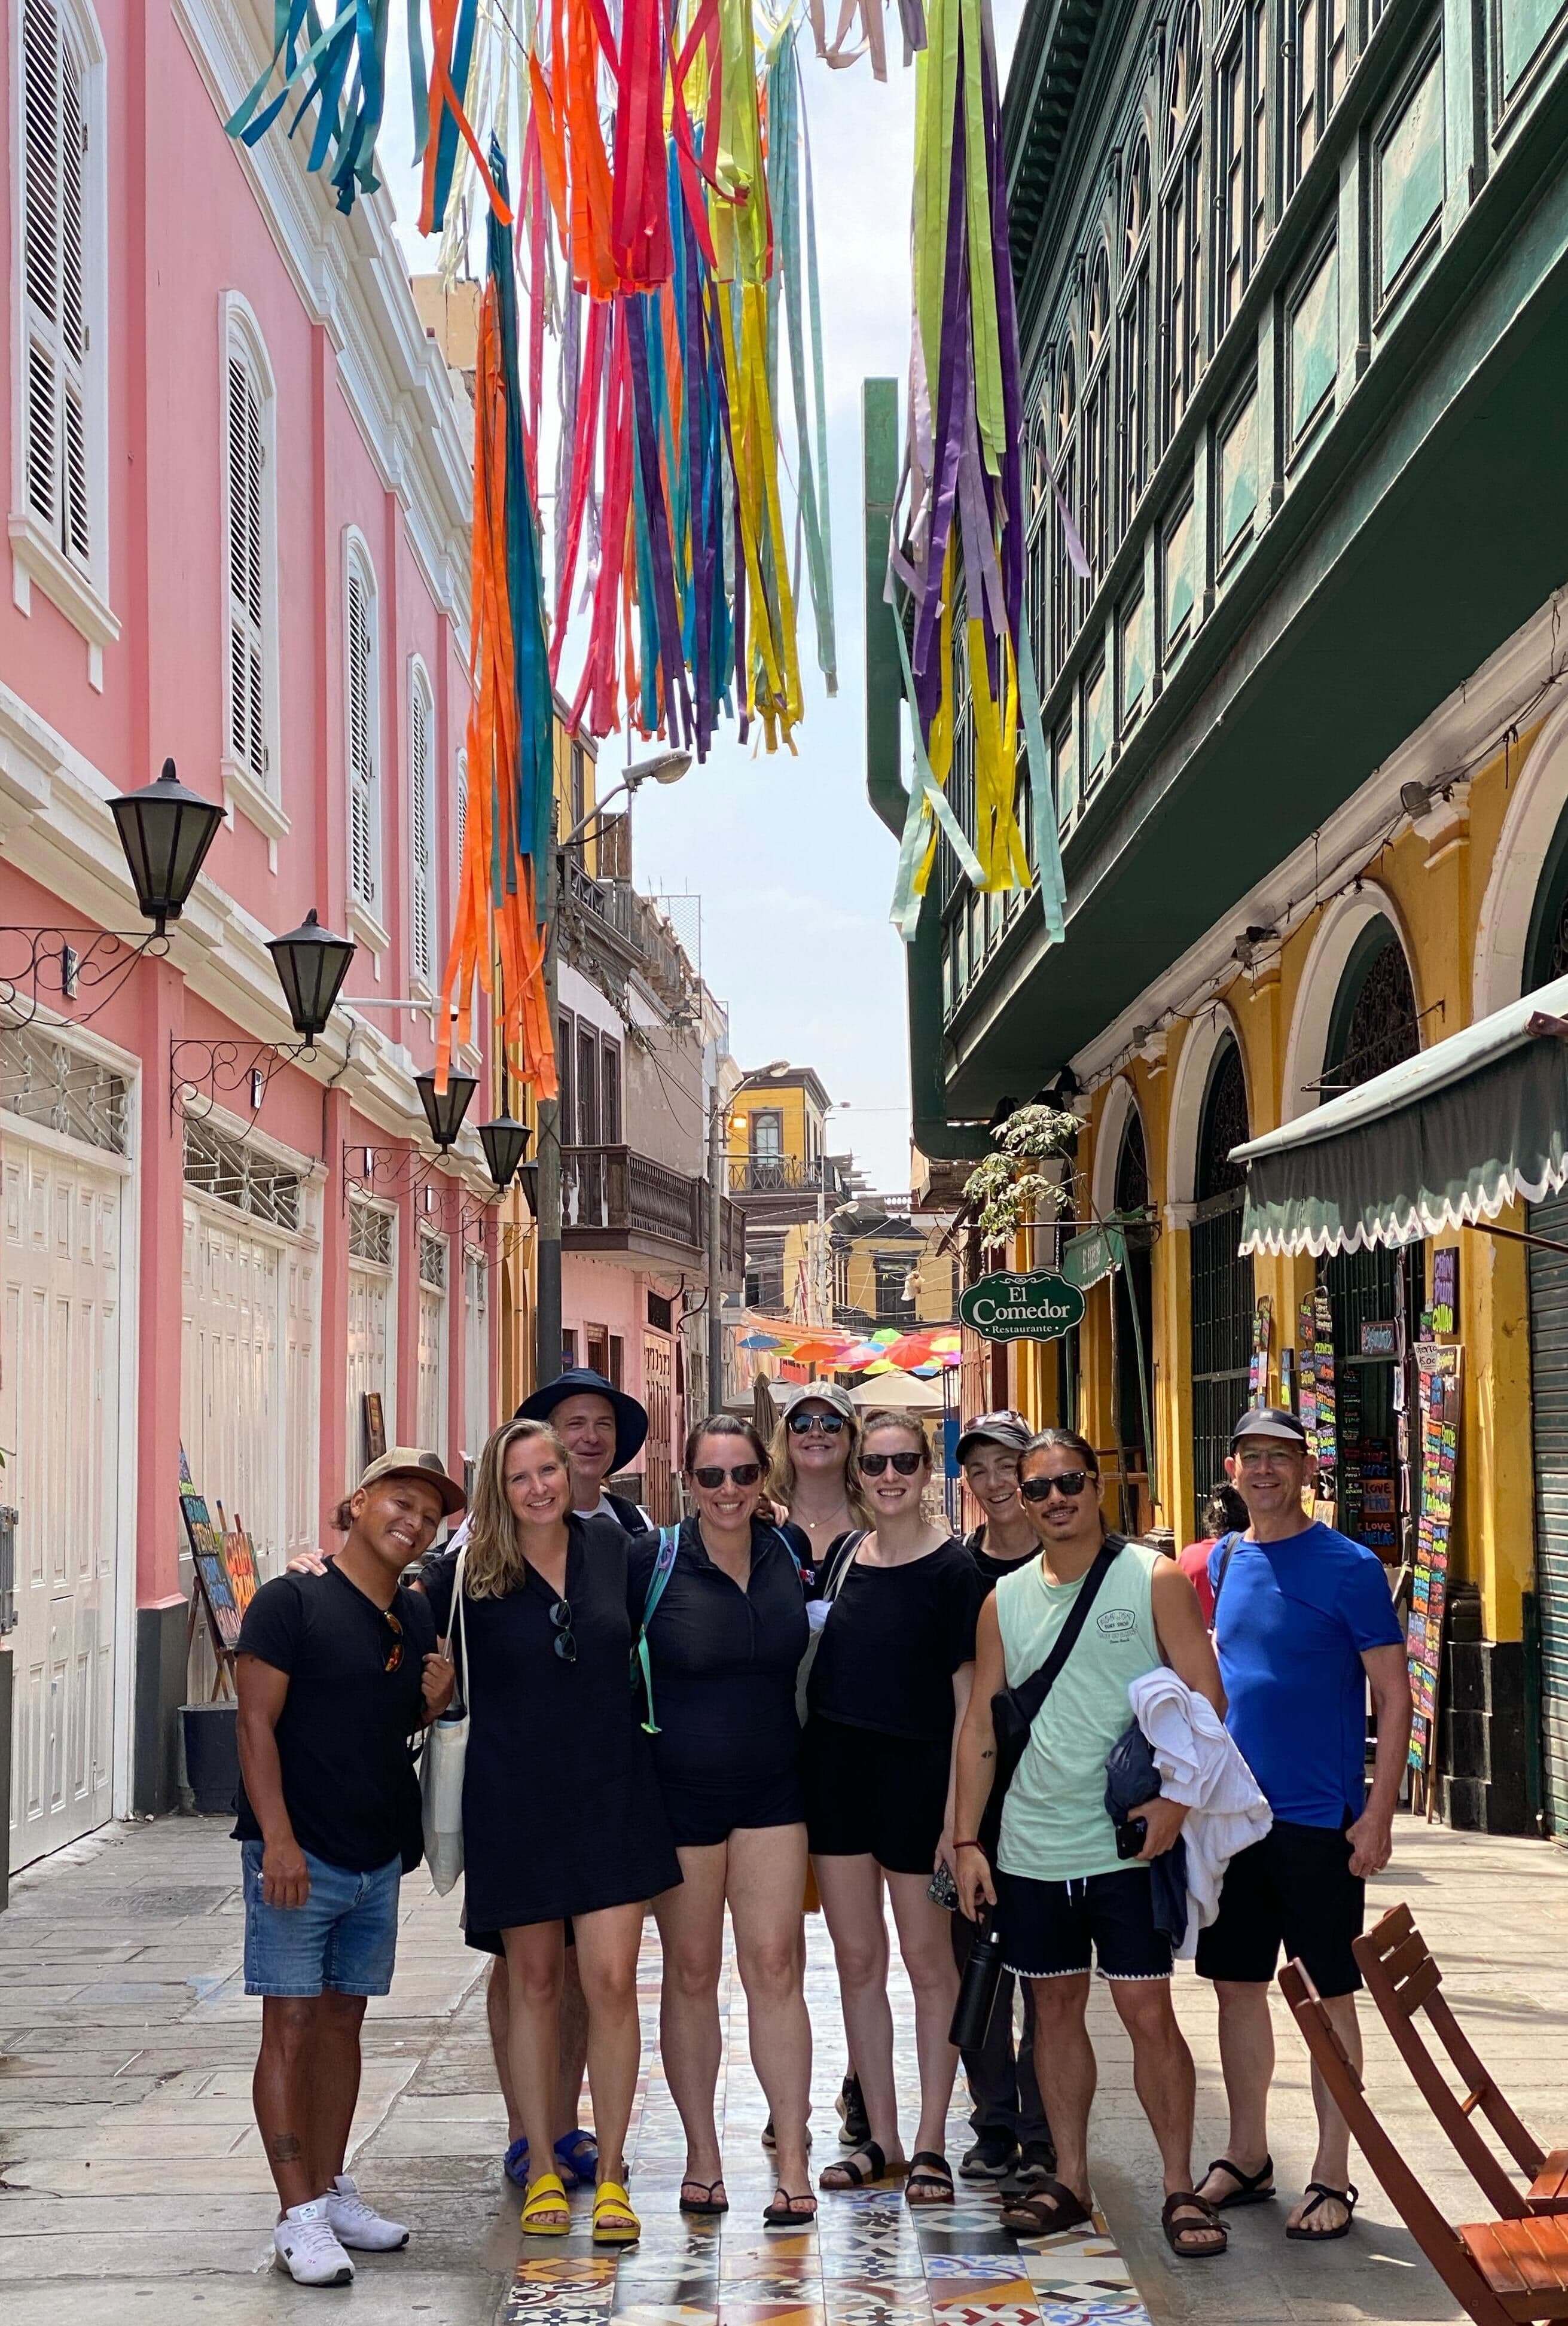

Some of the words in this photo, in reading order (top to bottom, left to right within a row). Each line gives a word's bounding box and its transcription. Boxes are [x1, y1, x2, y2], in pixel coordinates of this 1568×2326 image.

[1008, 1287, 1027, 1302] El
[972, 1298, 1070, 1325] Comedor
[992, 1325, 1053, 1334] Restaurante
